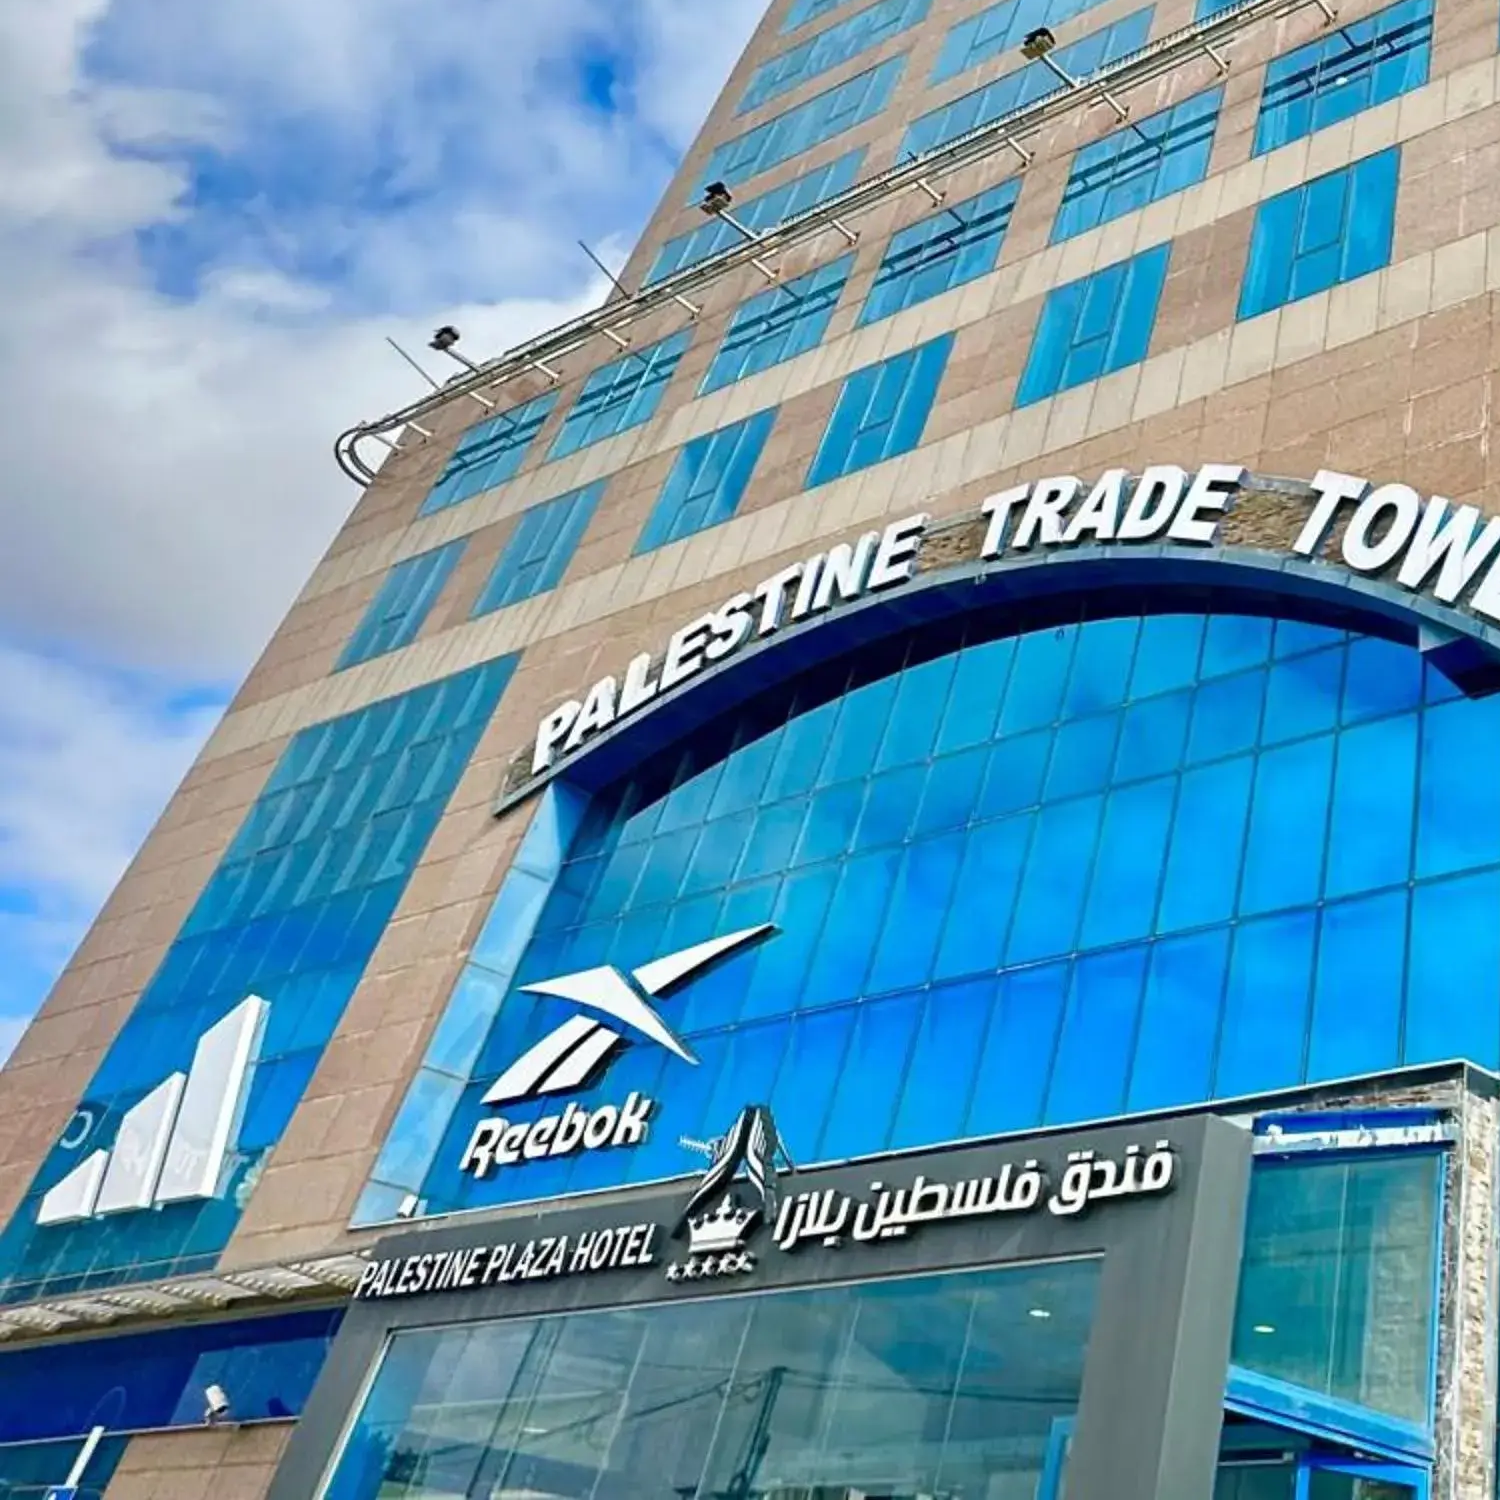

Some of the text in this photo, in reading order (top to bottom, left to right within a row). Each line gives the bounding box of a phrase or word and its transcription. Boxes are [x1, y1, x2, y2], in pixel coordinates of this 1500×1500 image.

[531, 513, 932, 775] PALESTINE
[979, 463, 1248, 559] TRADE
[459, 1091, 653, 1178] Reebok
[772, 1139, 1174, 1251] فندق فلسطين بلازا
[354, 1223, 657, 1299] PALESTINE PLAZA HOTEL
